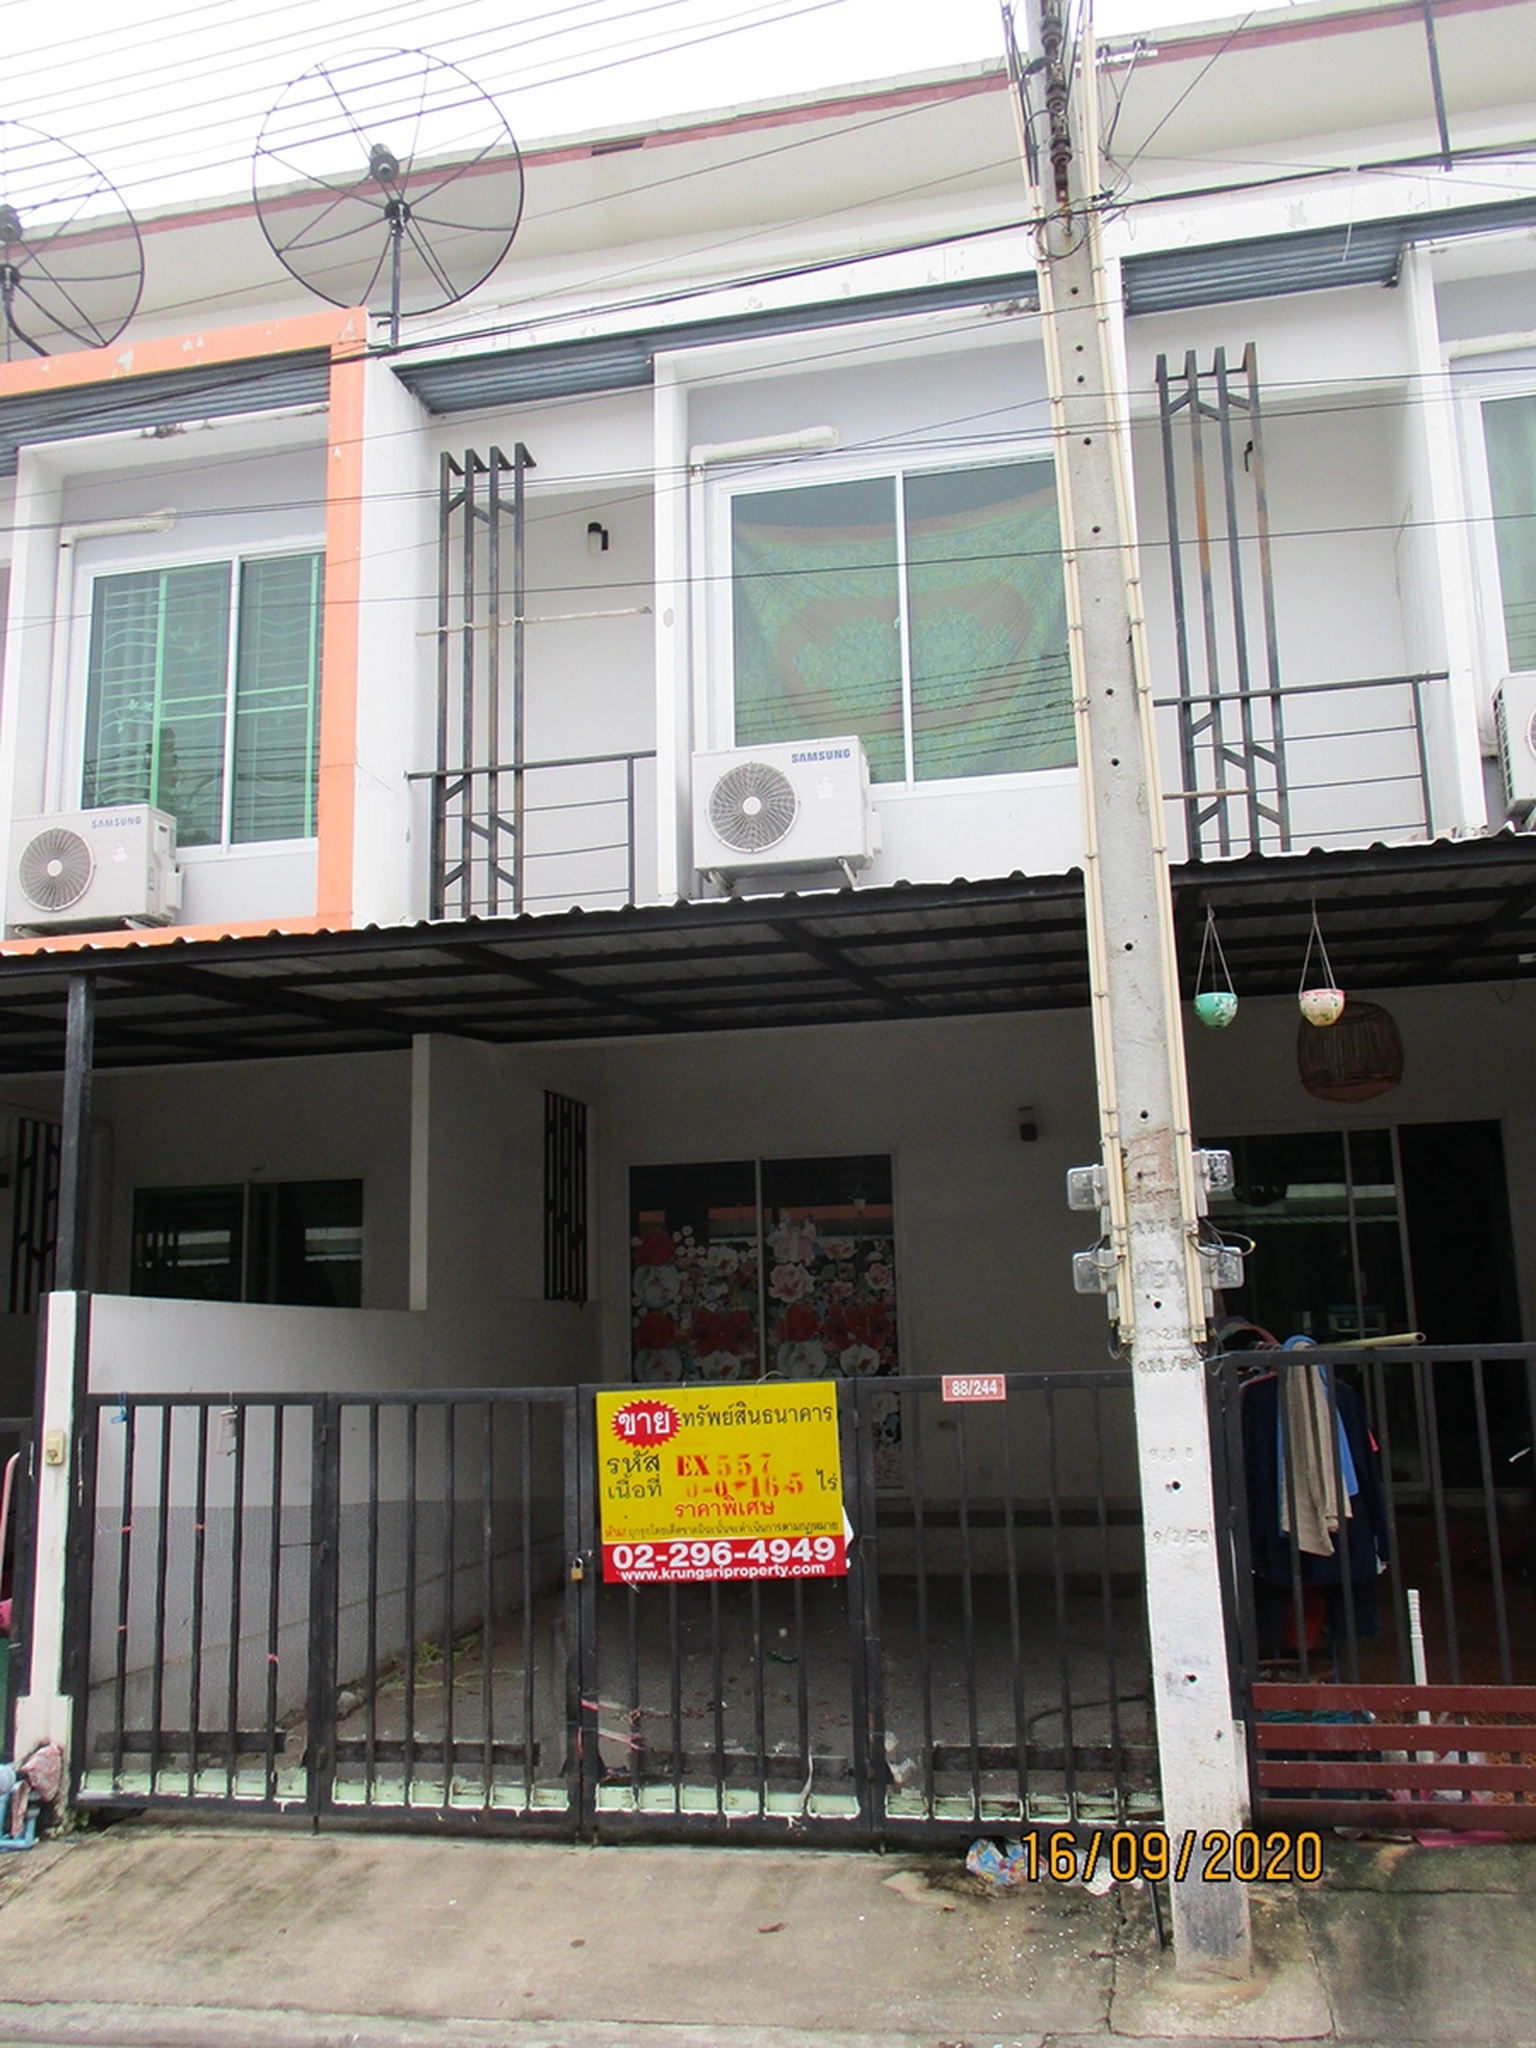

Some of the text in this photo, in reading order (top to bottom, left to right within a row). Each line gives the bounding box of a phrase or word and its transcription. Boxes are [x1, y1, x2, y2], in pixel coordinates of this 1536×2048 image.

[791, 748, 851, 764] SAMSUNG
[91, 815, 142, 830] SAMSUNG
[951, 1379, 998, 1397] 88/244
[617, 1400, 834, 1437] ขาย ทรัพย์สินธนาคาร
[606, 1449, 661, 1475] รหัส
[607, 1473, 663, 1500] เนื้อที่
[815, 1467, 839, 1492] ไร่
[674, 1494, 776, 1519] ราคาพิเศษ
[612, 1536, 836, 1570] 02-296-4949
[620, 1564, 827, 1582] www.krungsriproperty.com
